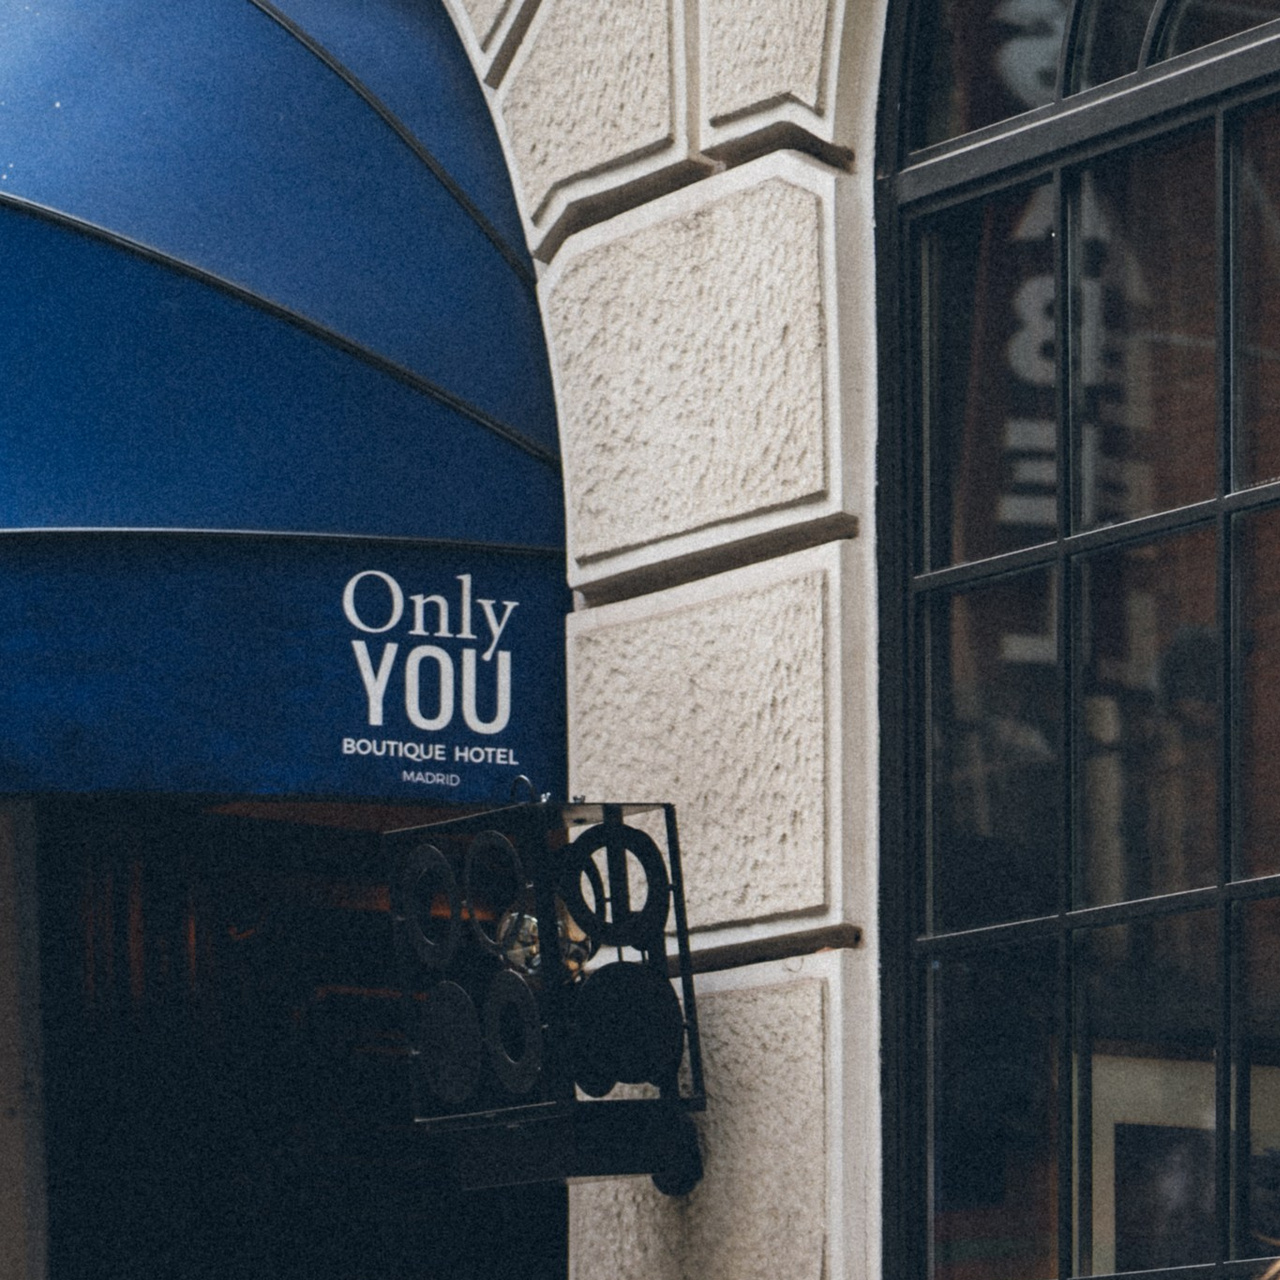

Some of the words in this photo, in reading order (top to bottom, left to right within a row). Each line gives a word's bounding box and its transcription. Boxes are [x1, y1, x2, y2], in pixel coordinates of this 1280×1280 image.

[342, 569, 520, 661] Only
[351, 639, 512, 735] YOU
[341, 737, 447, 762] BOUTIQUE
[454, 746, 520, 766] HOTEL
[402, 770, 461, 787] MADRID
